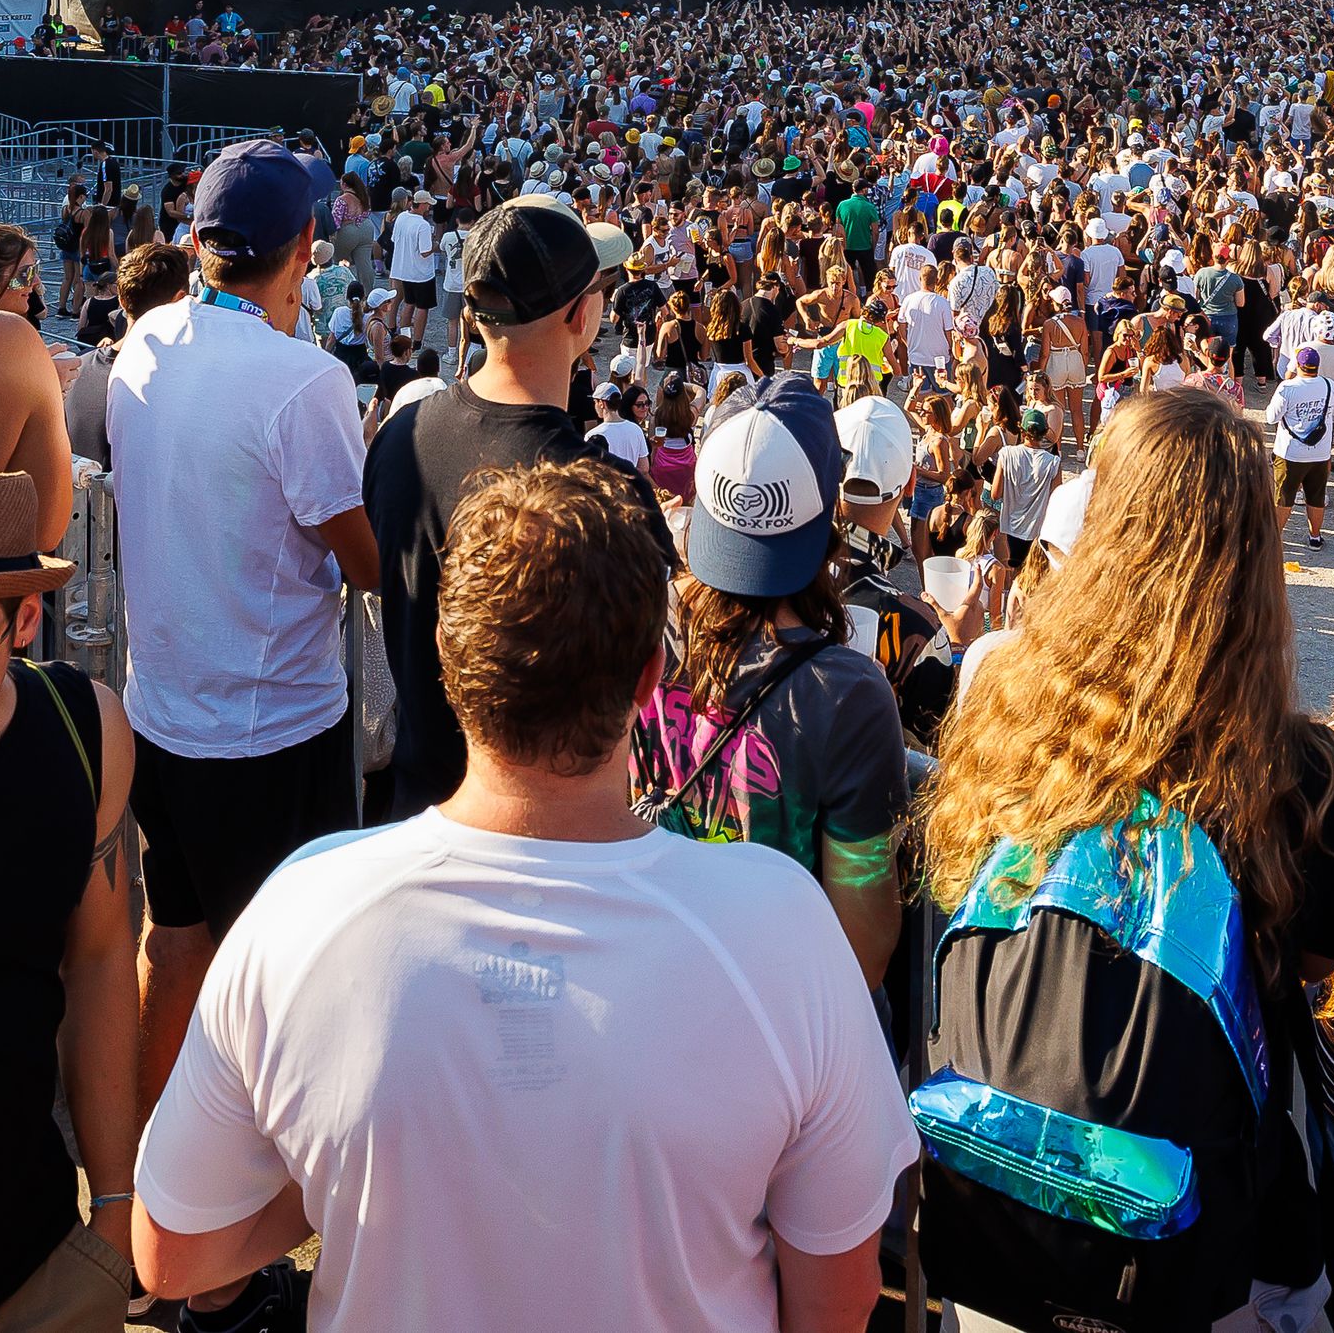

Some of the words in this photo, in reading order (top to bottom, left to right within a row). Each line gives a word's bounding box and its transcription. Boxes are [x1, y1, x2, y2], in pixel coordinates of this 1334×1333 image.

[10, 14, 32, 22] KREUZ
[241, 302, 264, 318] CLUB
[765, 516, 794, 529] FOX
